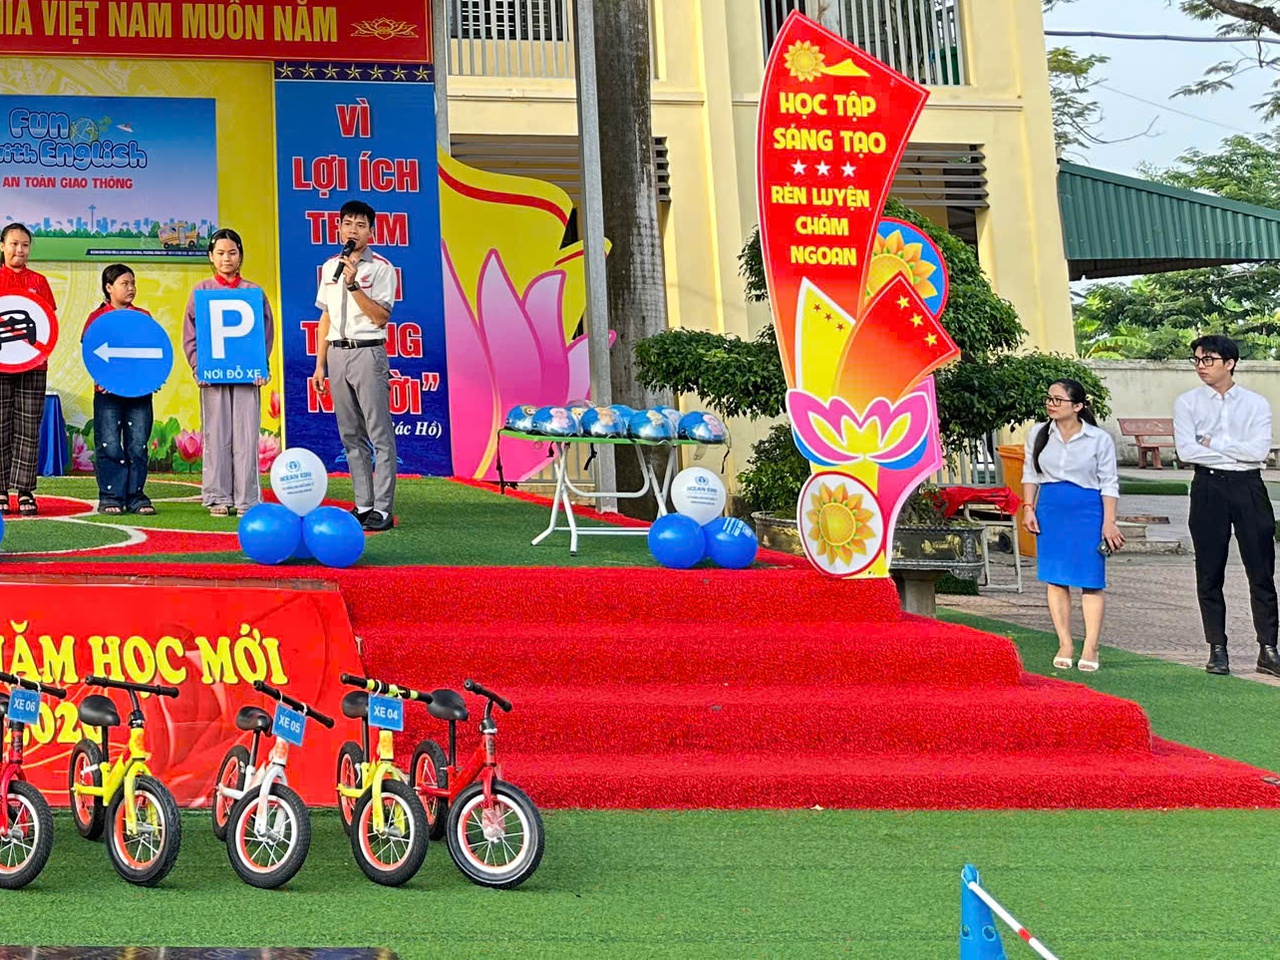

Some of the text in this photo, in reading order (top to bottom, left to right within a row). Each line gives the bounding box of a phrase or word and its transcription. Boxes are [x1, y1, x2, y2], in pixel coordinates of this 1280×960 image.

[108, 1, 173, 38] NAM
[335, 97, 372, 139] VÌ
[779, 90, 876, 122] HỌC TẬP
[9, 108, 70, 139] Fun
[38, 140, 148, 171] English
[773, 124, 886, 158] SÁNG TẠO
[2, 174, 133, 189] AN TOÀN GIAO THÔNG
[292, 150, 420, 198] LỢI ÍCH
[771, 182, 870, 211] RÈN LUYỆN
[795, 214, 849, 236] CHĂM
[790, 246, 857, 266] NGOAN
[209, 299, 255, 359] P
[204, 365, 261, 379] NƠI ĐỖ XE
[195, 623, 288, 685] MỚI
[14, 698, 36, 712] XE 06
[373, 705, 398, 719] XE 04
[278, 715, 301, 733] XE 05
